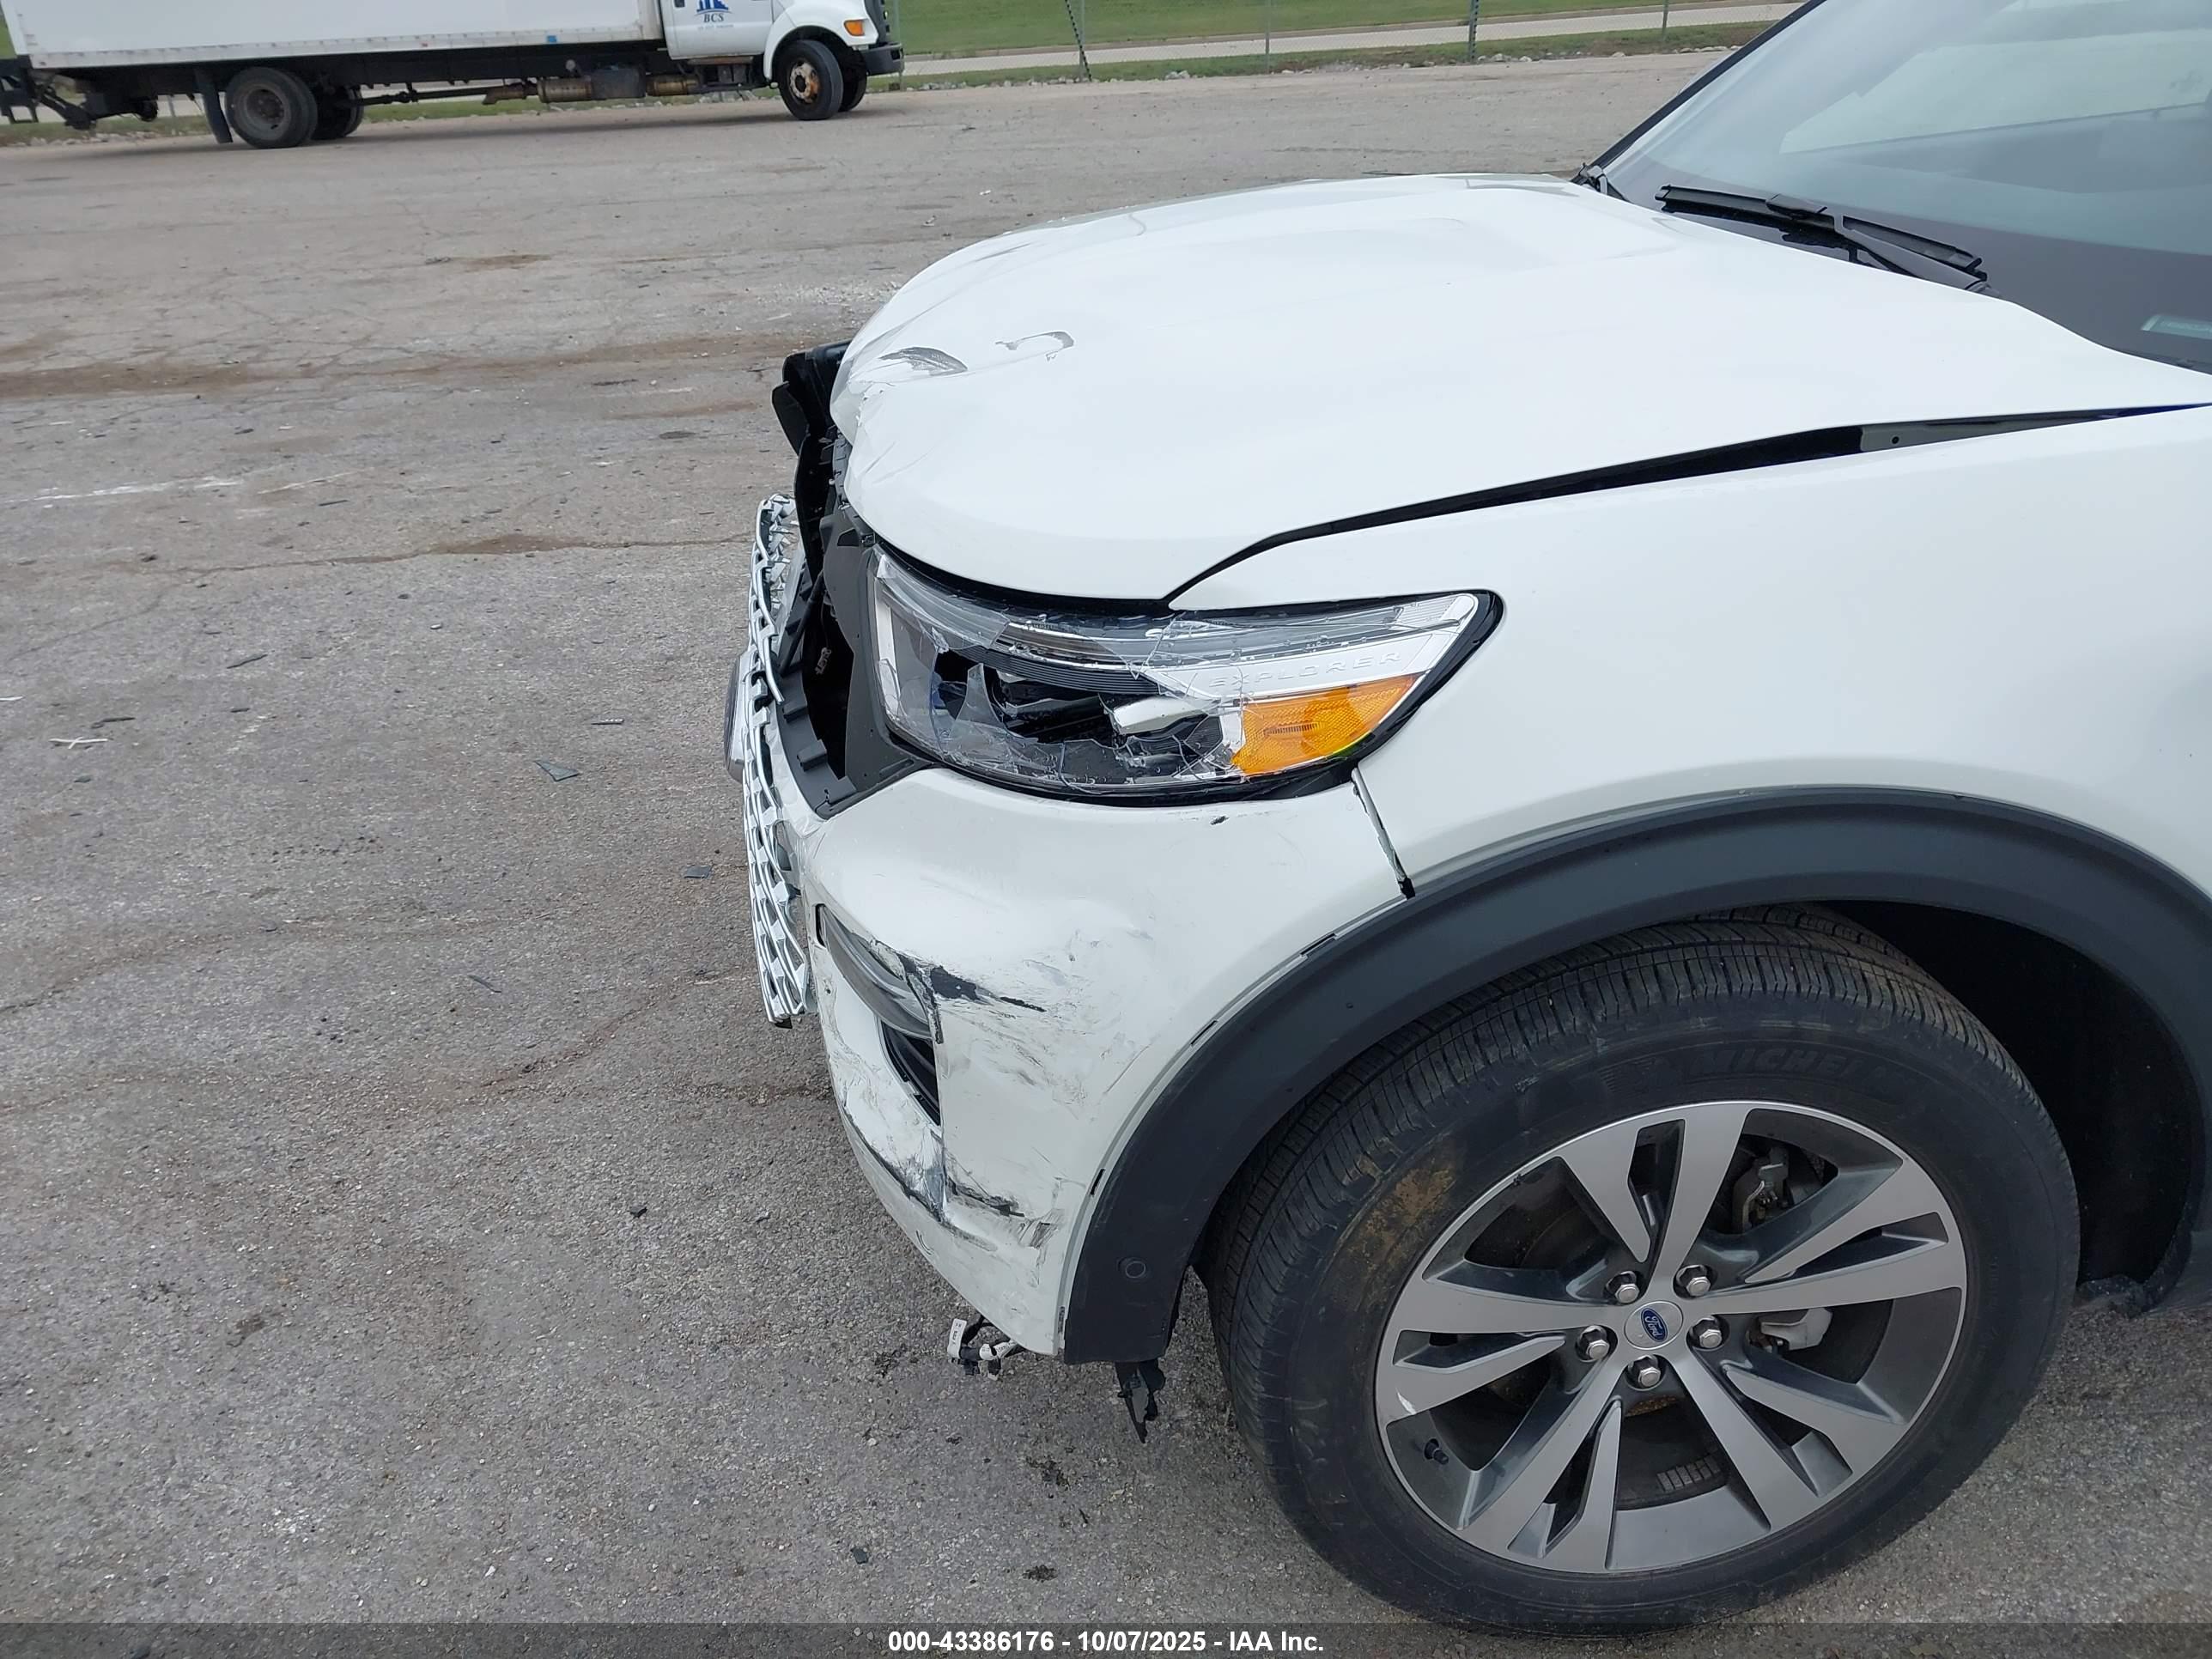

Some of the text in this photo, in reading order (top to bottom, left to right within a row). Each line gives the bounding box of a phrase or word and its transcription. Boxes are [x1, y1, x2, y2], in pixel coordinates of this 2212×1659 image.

[703, 13, 725, 23] BCS
[1208, 651, 1402, 688] EXPLORER
[1644, 1314, 1664, 1337] Ford
